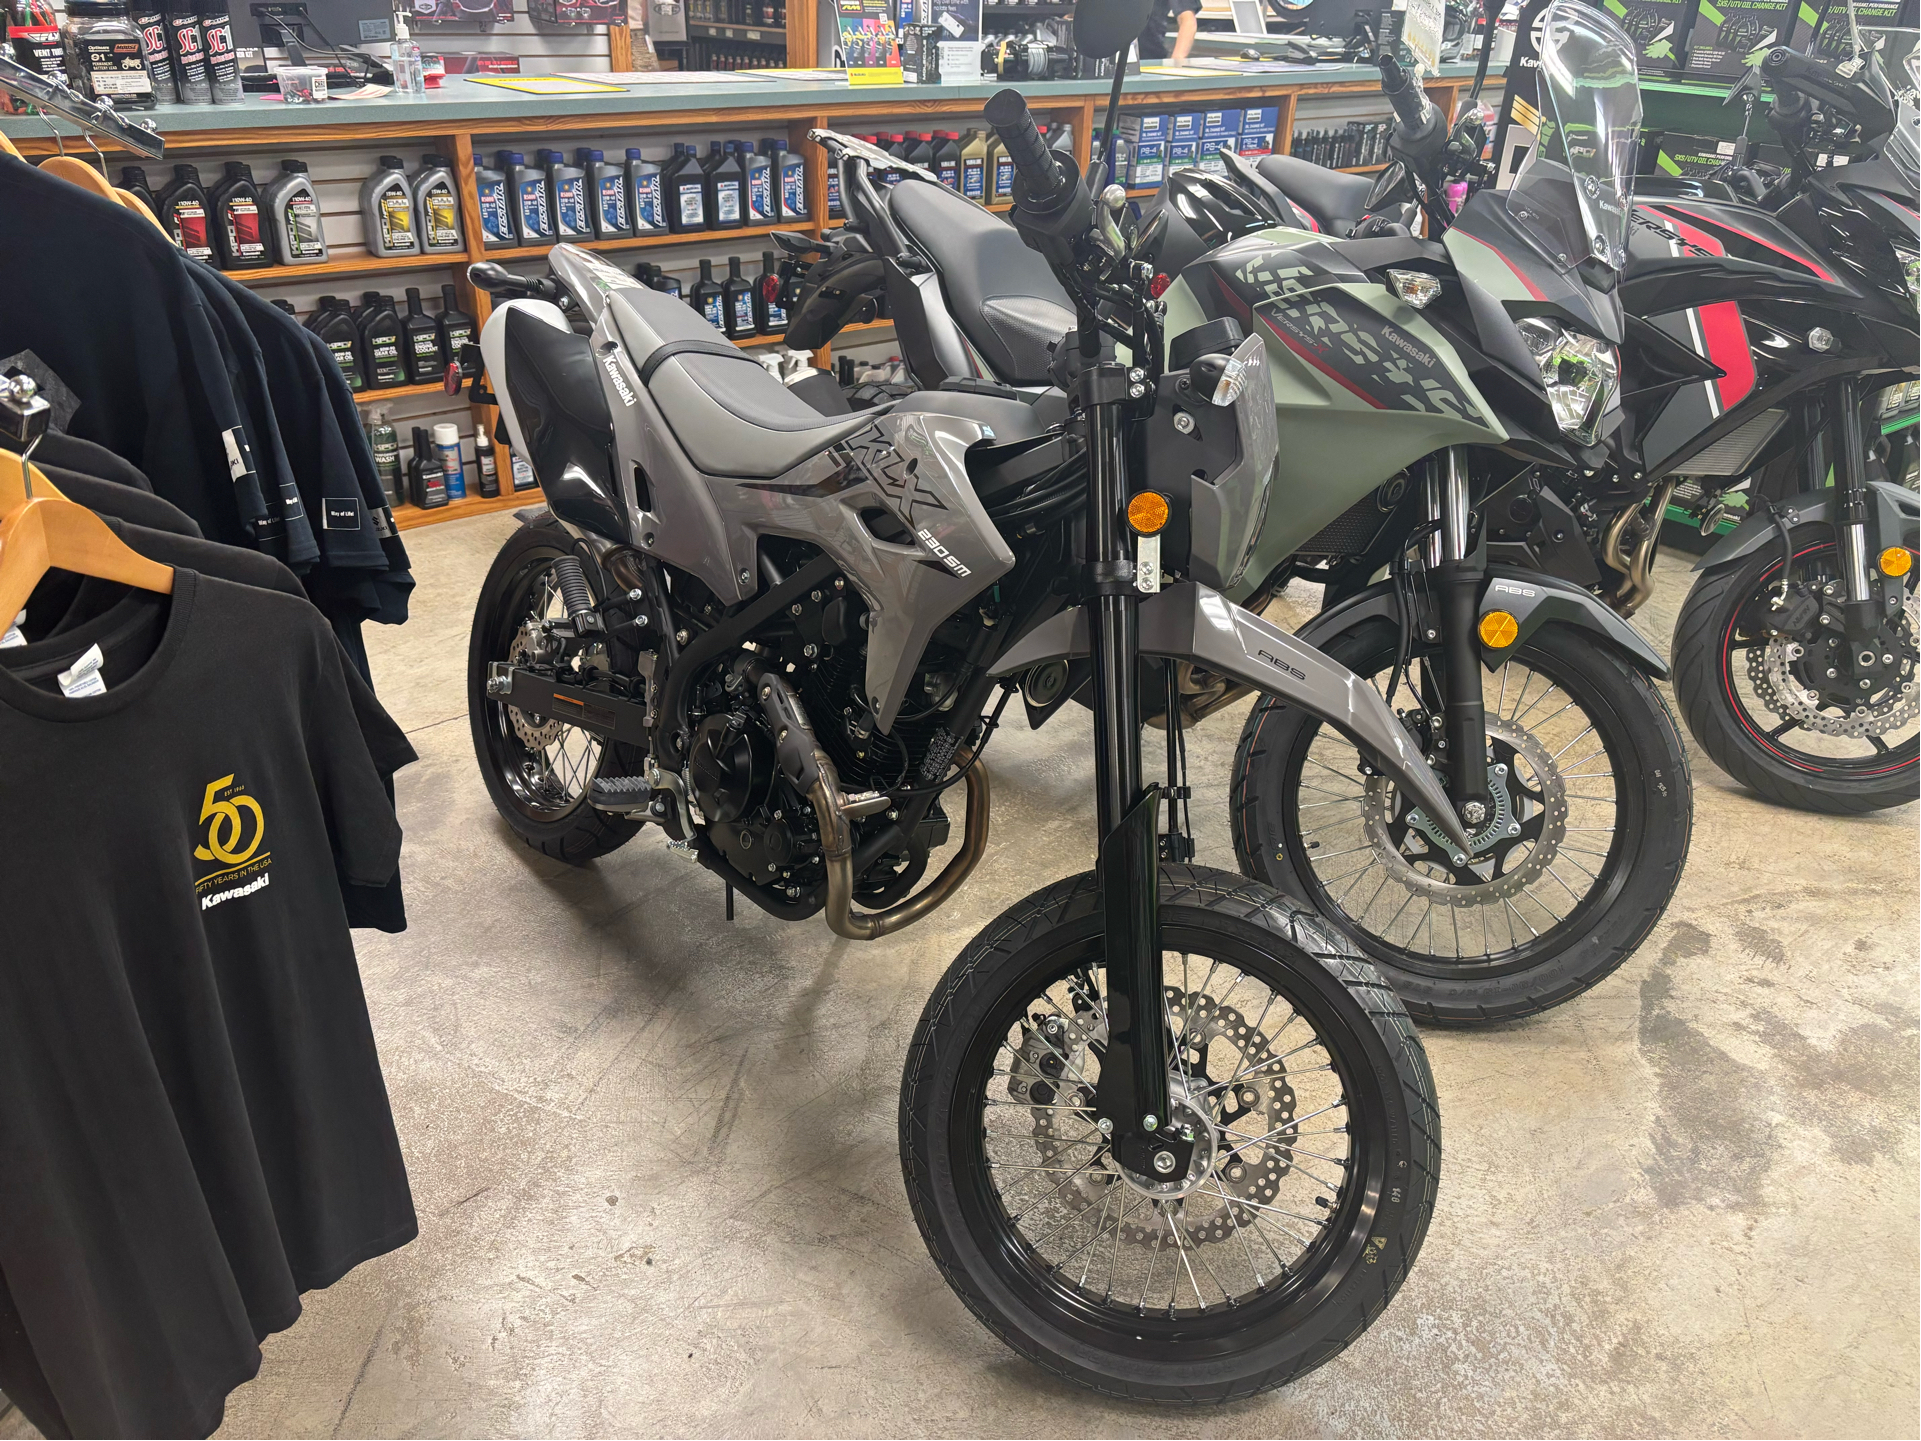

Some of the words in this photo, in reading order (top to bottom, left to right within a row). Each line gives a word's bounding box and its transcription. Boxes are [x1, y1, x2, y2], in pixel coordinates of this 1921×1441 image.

[1752, 2, 1776, 10] CHANGE
[1859, 8, 1883, 16] CHANGE
[1883, 9, 1897, 17] KIT
[33, 49, 50, 57] VENT
[143, 22, 167, 53] SC1
[177, 24, 203, 55] SC1
[207, 24, 234, 55] SC1
[1173, 147, 1189, 155] PS-4
[1204, 142, 1224, 151] PS-4
[1674, 154, 1698, 163] SXS/UTV
[1698, 156, 1707, 164] OIL
[536, 180, 549, 235] ECSTAR
[573, 178, 586, 232] ECSTAR
[614, 176, 626, 229] ECSTAR
[650, 174, 662, 226] ECSTAR
[761, 167, 771, 217] ECSTAR
[794, 165, 803, 214] ECSTAR
[494, 182, 509, 238] ECSTAR
[1632, 208, 1714, 257] ERSYS
[1271, 308, 1329, 354] VERSYS-X
[1381, 324, 1437, 369] Kawasaki
[603, 355, 637, 407] Kawasaki
[375, 455, 395, 463] WASH
[845, 420, 949, 530] KLX
[1495, 584, 1536, 598] ABS
[1257, 649, 1306, 681] ABS
[193, 773, 265, 864] 50
[196, 881, 213, 894] FIFTY
[214, 872, 239, 886] YEARS
[240, 868, 247, 878] IN
[247, 864, 260, 874] THE
[260, 858, 272, 868] USA
[202, 873, 270, 911] Kawasaki
